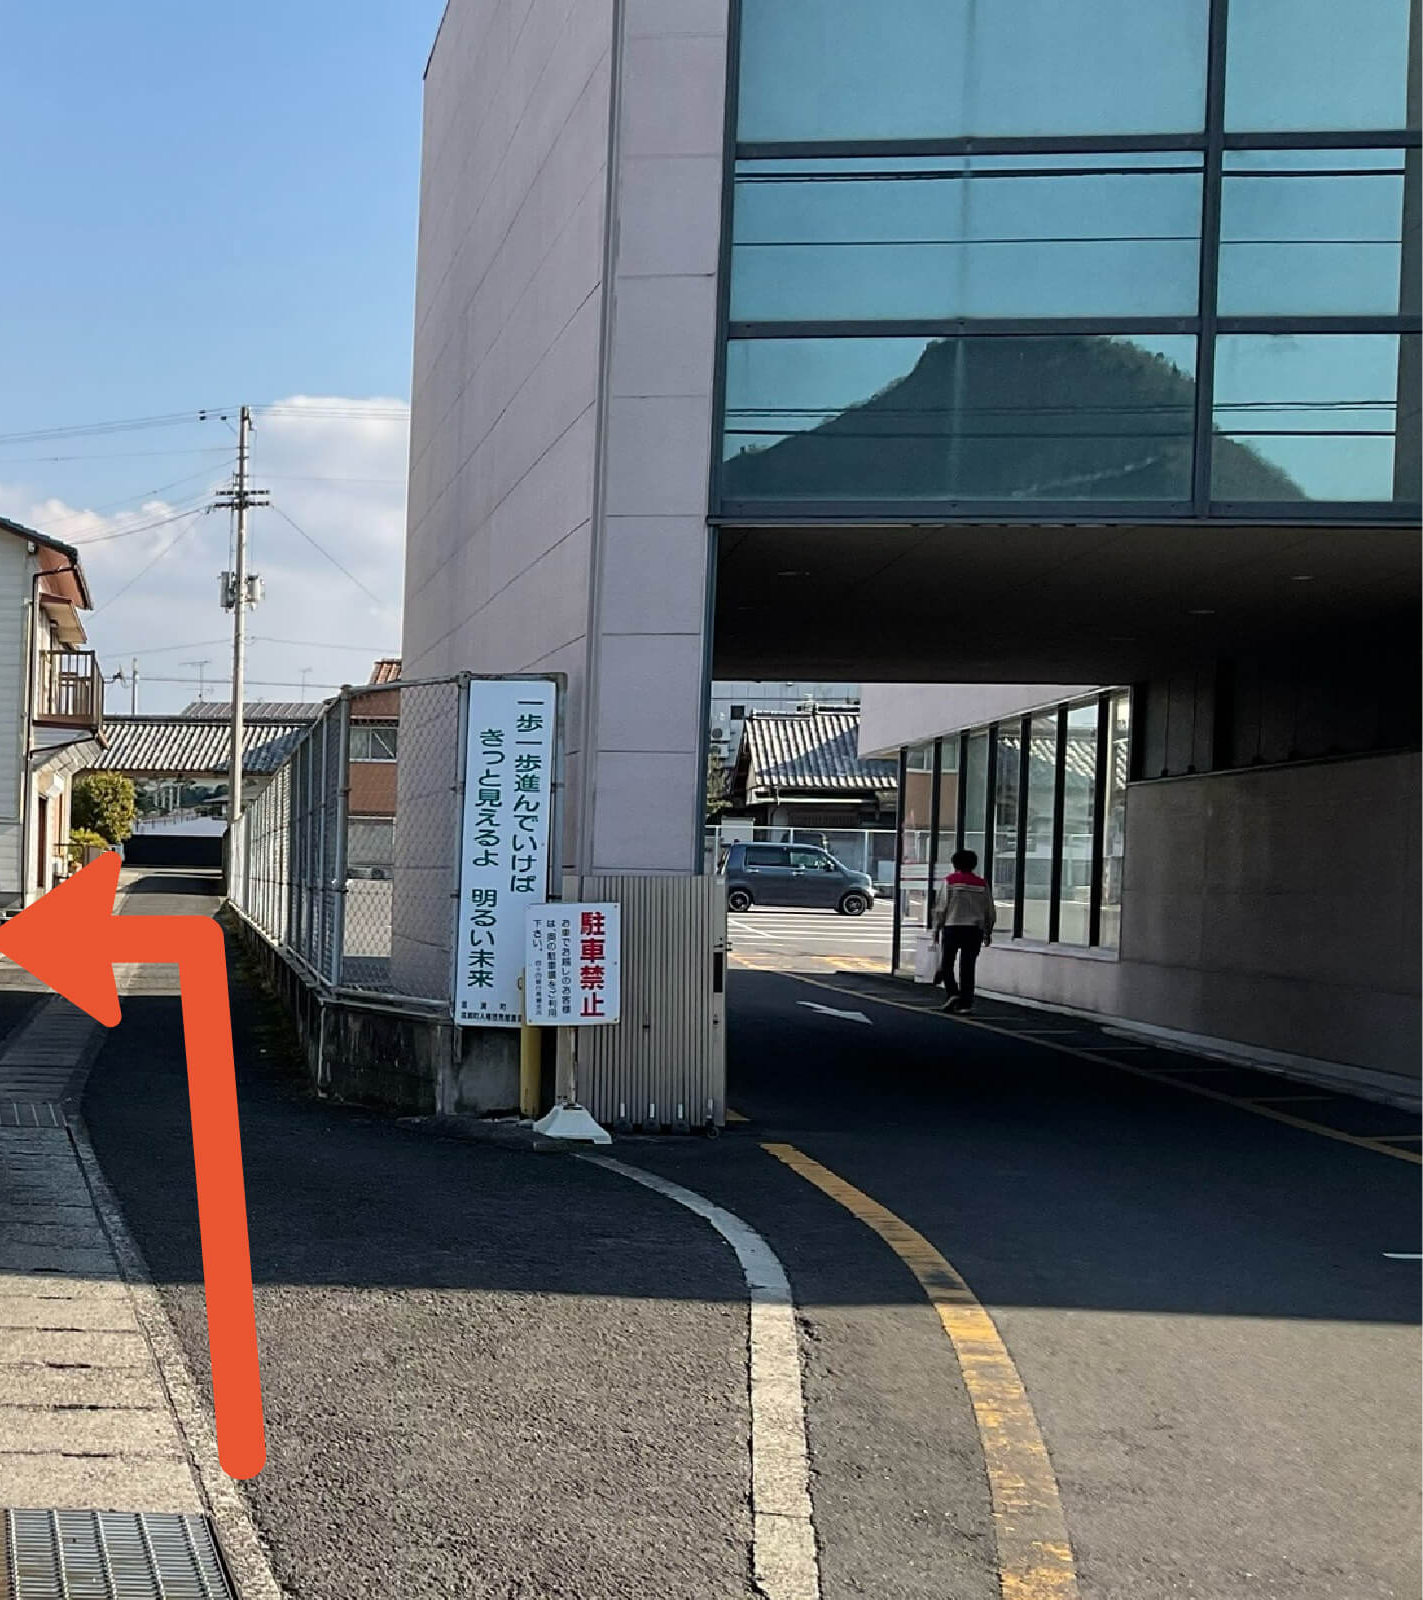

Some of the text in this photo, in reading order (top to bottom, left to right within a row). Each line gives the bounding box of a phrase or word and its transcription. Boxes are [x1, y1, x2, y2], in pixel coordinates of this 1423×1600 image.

[510, 701, 544, 893] 一歩一歩進んでいけば
[467, 889, 497, 988] 明るい未来
[580, 912, 605, 1017] 駐車禁止
